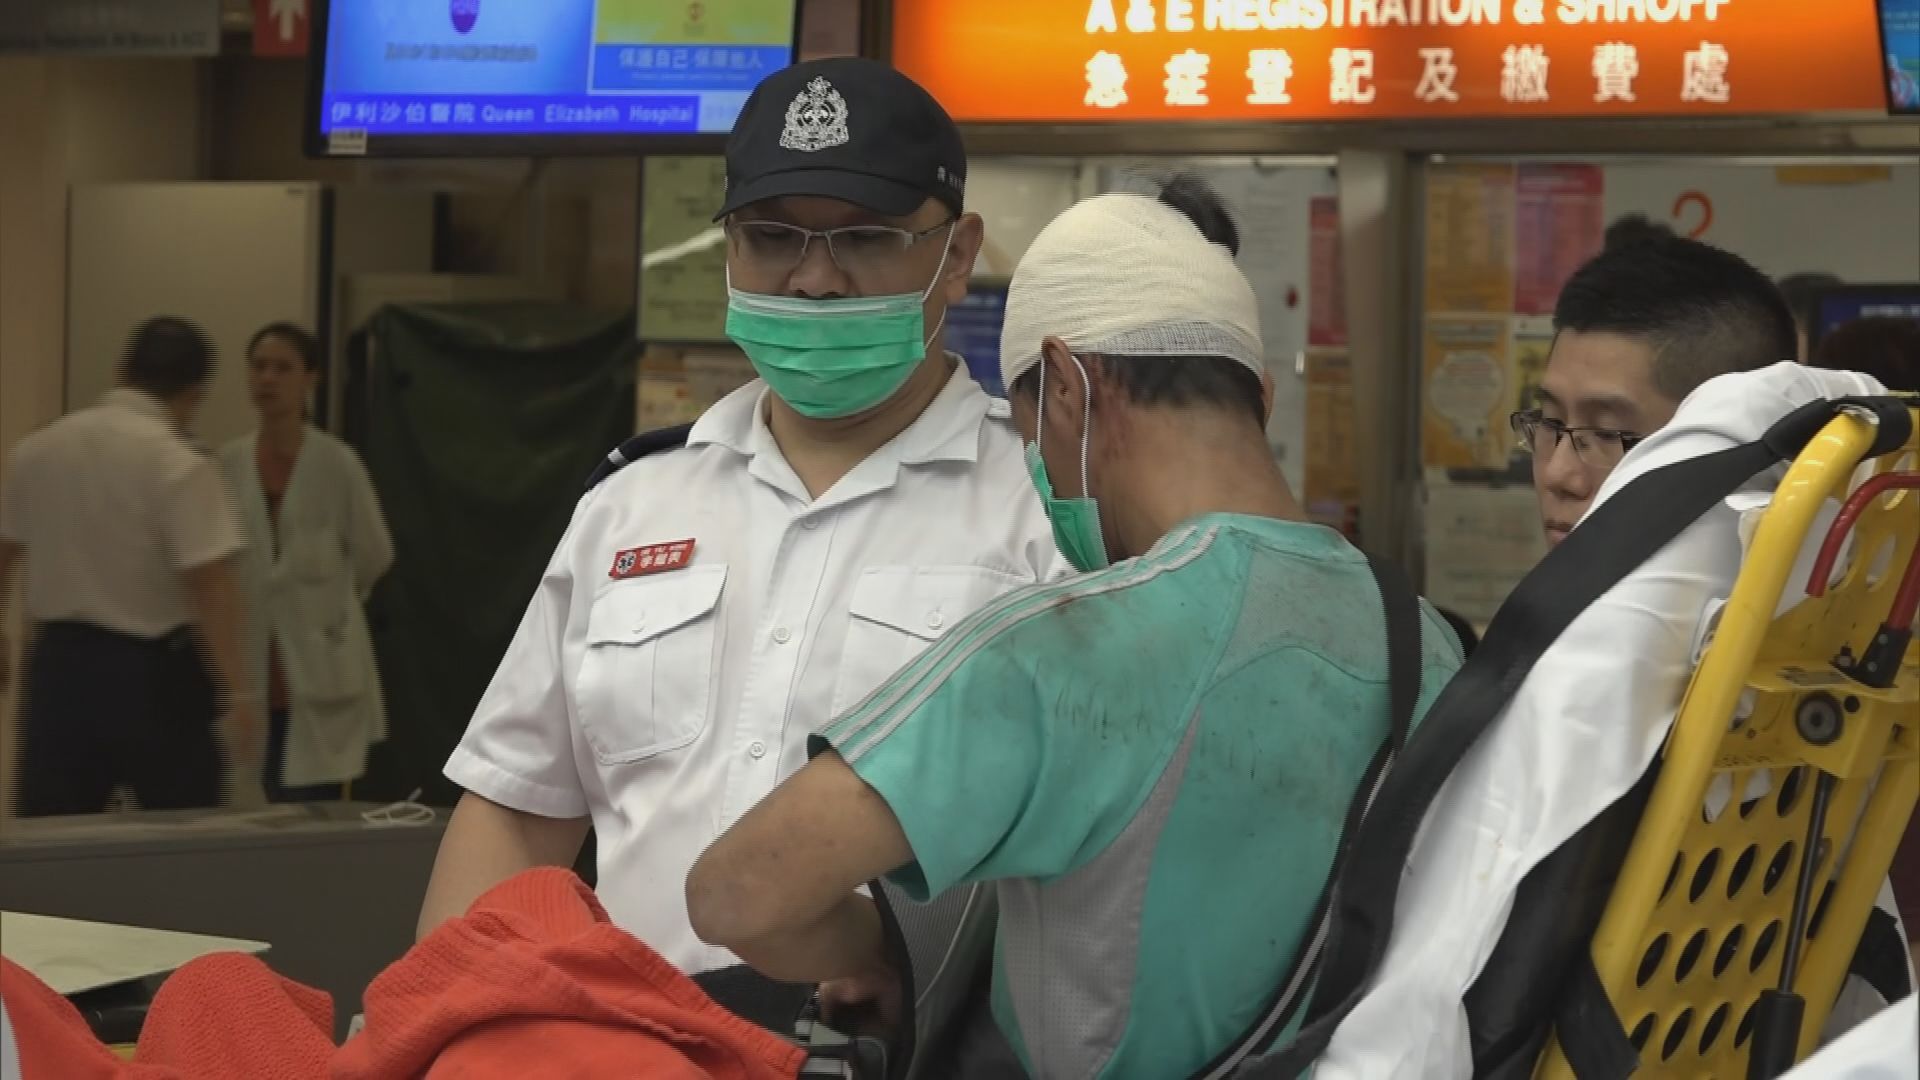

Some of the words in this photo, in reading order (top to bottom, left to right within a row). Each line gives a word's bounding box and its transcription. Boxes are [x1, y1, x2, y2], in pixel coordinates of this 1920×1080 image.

[1085, 40, 1731, 106] 急症登記及繳費處
[330, 101, 475, 124] 伊利沙伯醫院
[482, 104, 535, 123] Queen
[545, 103, 620, 123] Elizabeth
[629, 104, 695, 126] Hospital
